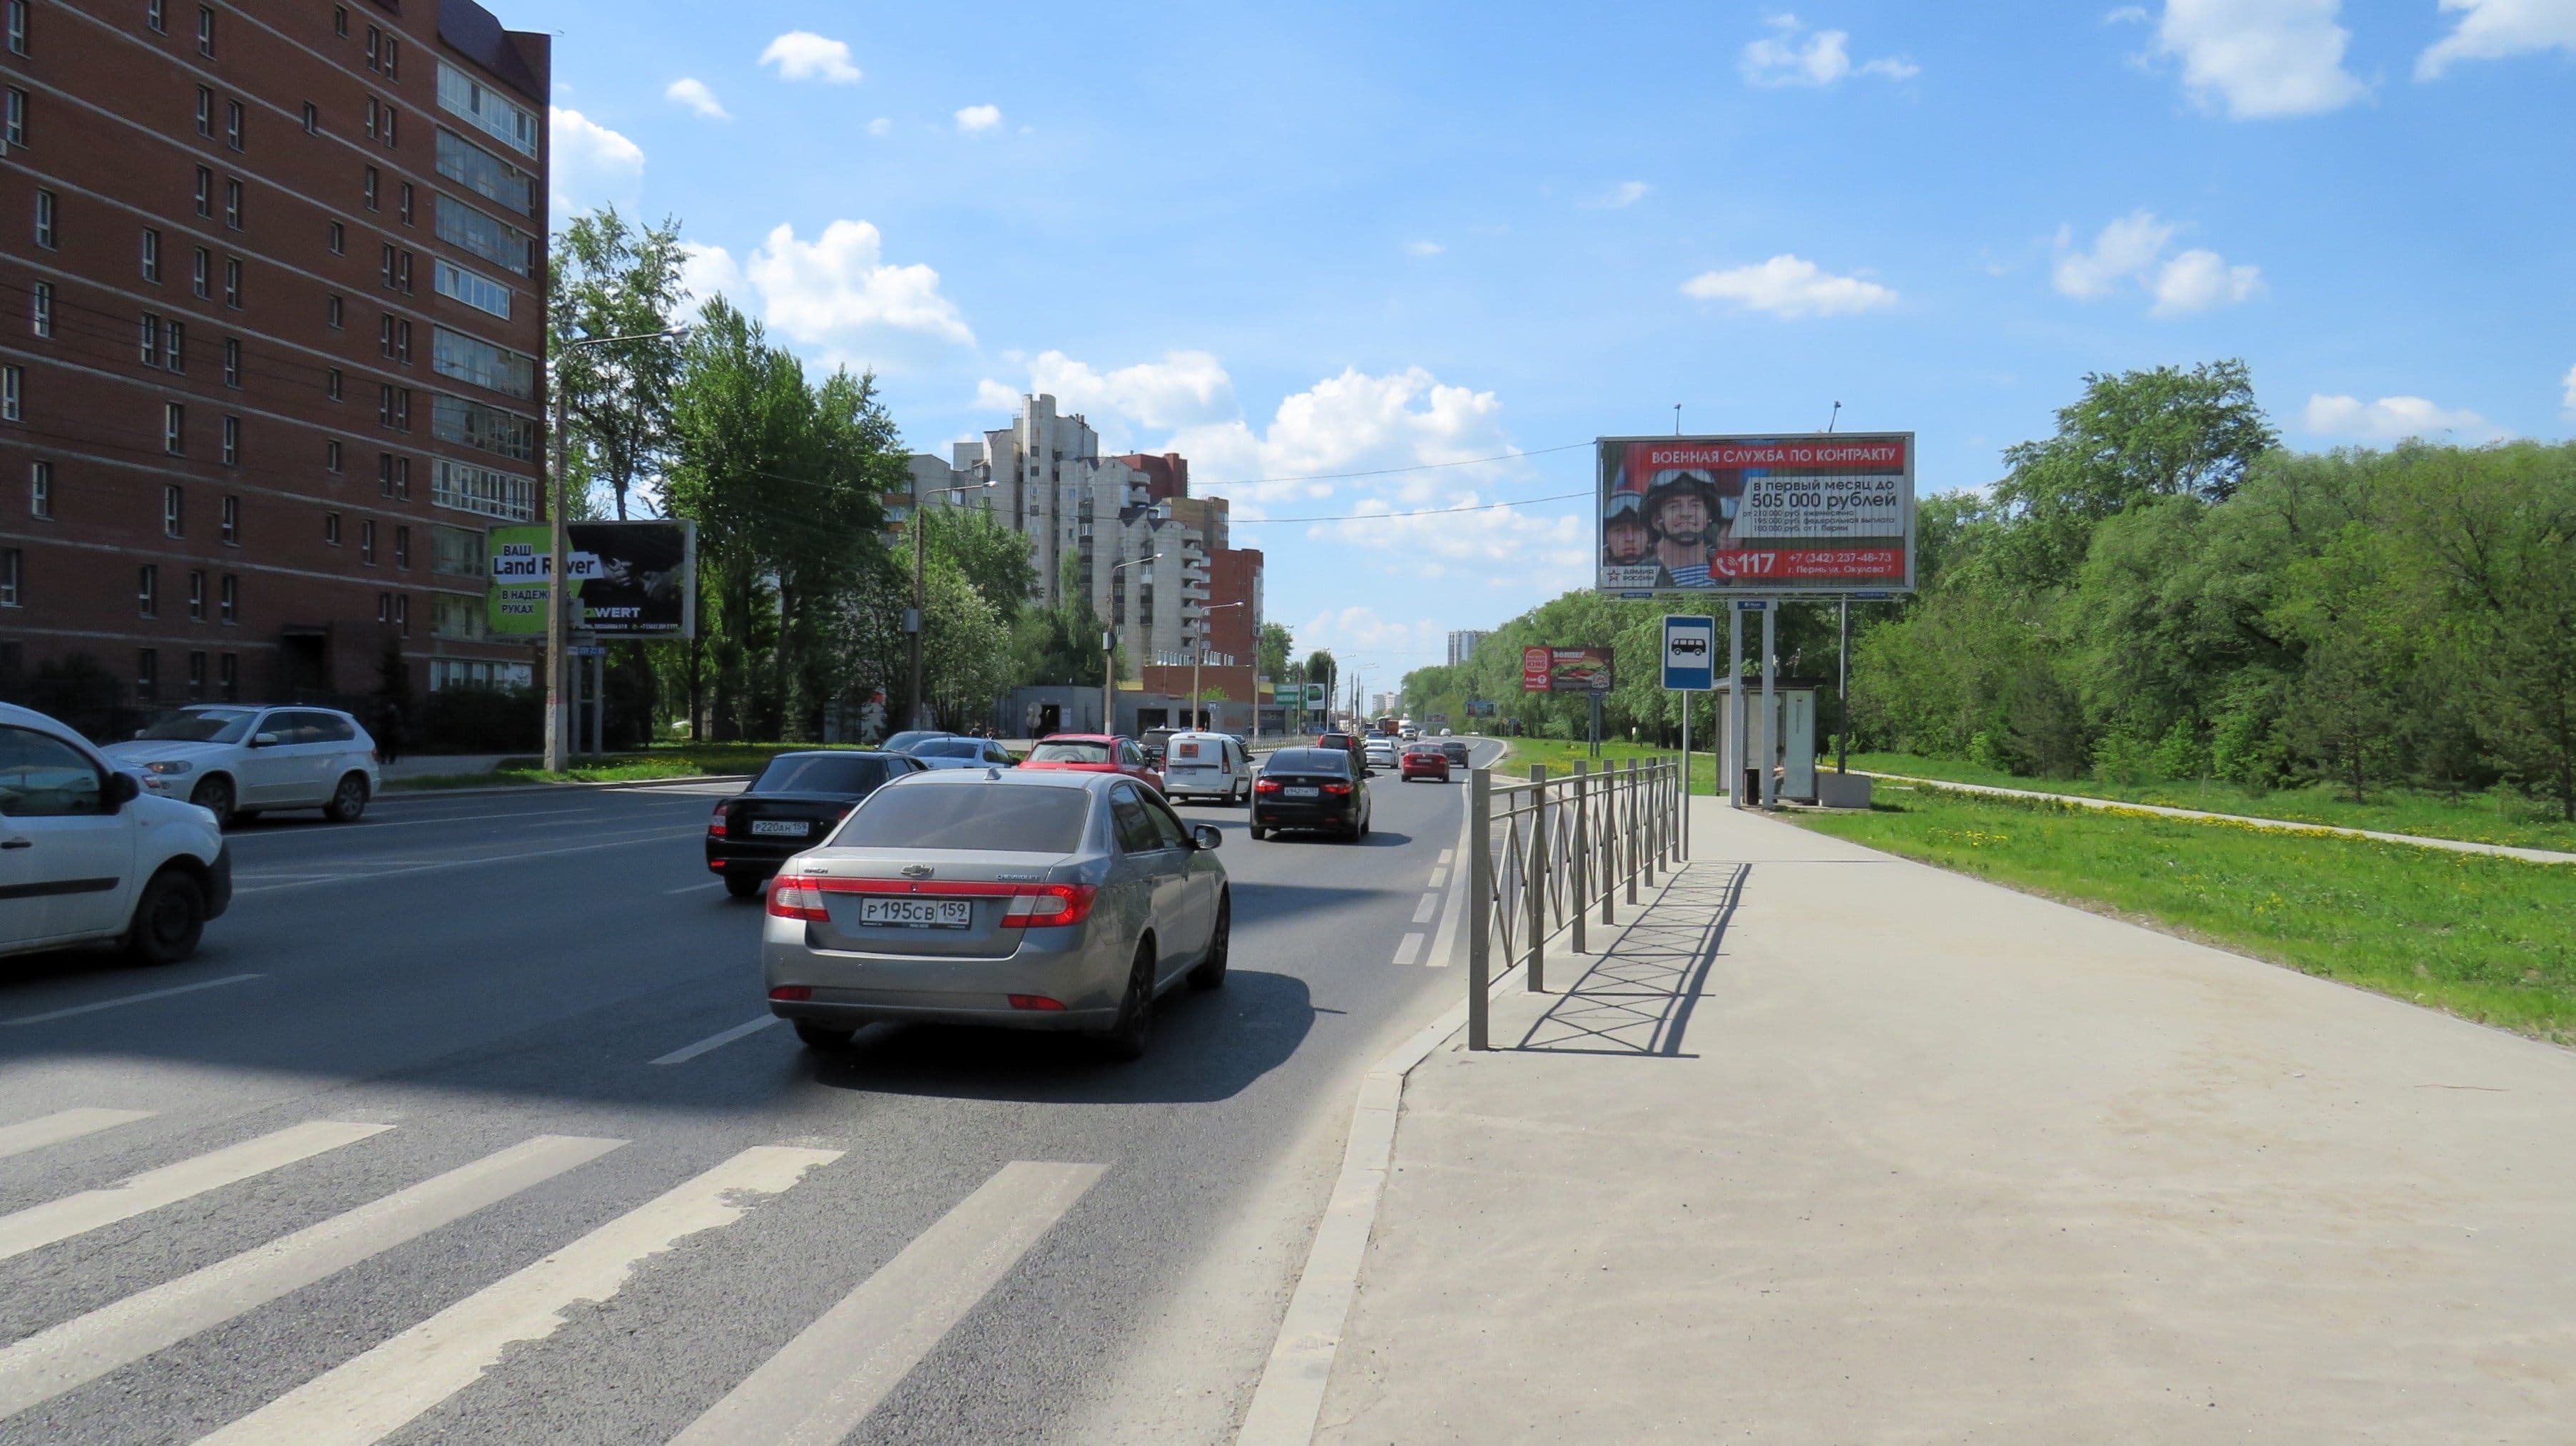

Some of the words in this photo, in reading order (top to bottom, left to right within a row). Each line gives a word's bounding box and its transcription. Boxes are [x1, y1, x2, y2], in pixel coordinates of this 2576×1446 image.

[1652, 451, 1719, 464] ВОЕННАЯ
[1724, 449, 1784, 463] СЛУЖБА
[1791, 449, 1811, 462] ПО
[1817, 448, 1896, 462] КОНТРАКТУ
[1753, 482, 1761, 491] в
[1766, 479, 1821, 492] первый
[1825, 481, 1872, 492] месяц
[1875, 481, 1895, 491] до
[1752, 493, 1783, 507] 505
[1788, 493, 1821, 507] 000
[1826, 492, 1897, 509] рублей
[1803, 517, 1859, 526] федеральная
[503, 545, 532, 556] ВАШ
[1738, 553, 1776, 574] 117
[1789, 554, 1802, 562] +7
[1805, 553, 1834, 564] (342)
[494, 557, 536, 575] Land
[541, 557, 595, 575] Rver
[502, 591, 508, 599] В
[502, 604, 534, 613] РУКАХ
[793, 822, 807, 830] 159
[866, 902, 935, 921] Р195СВ
[939, 902, 966, 917] 159
